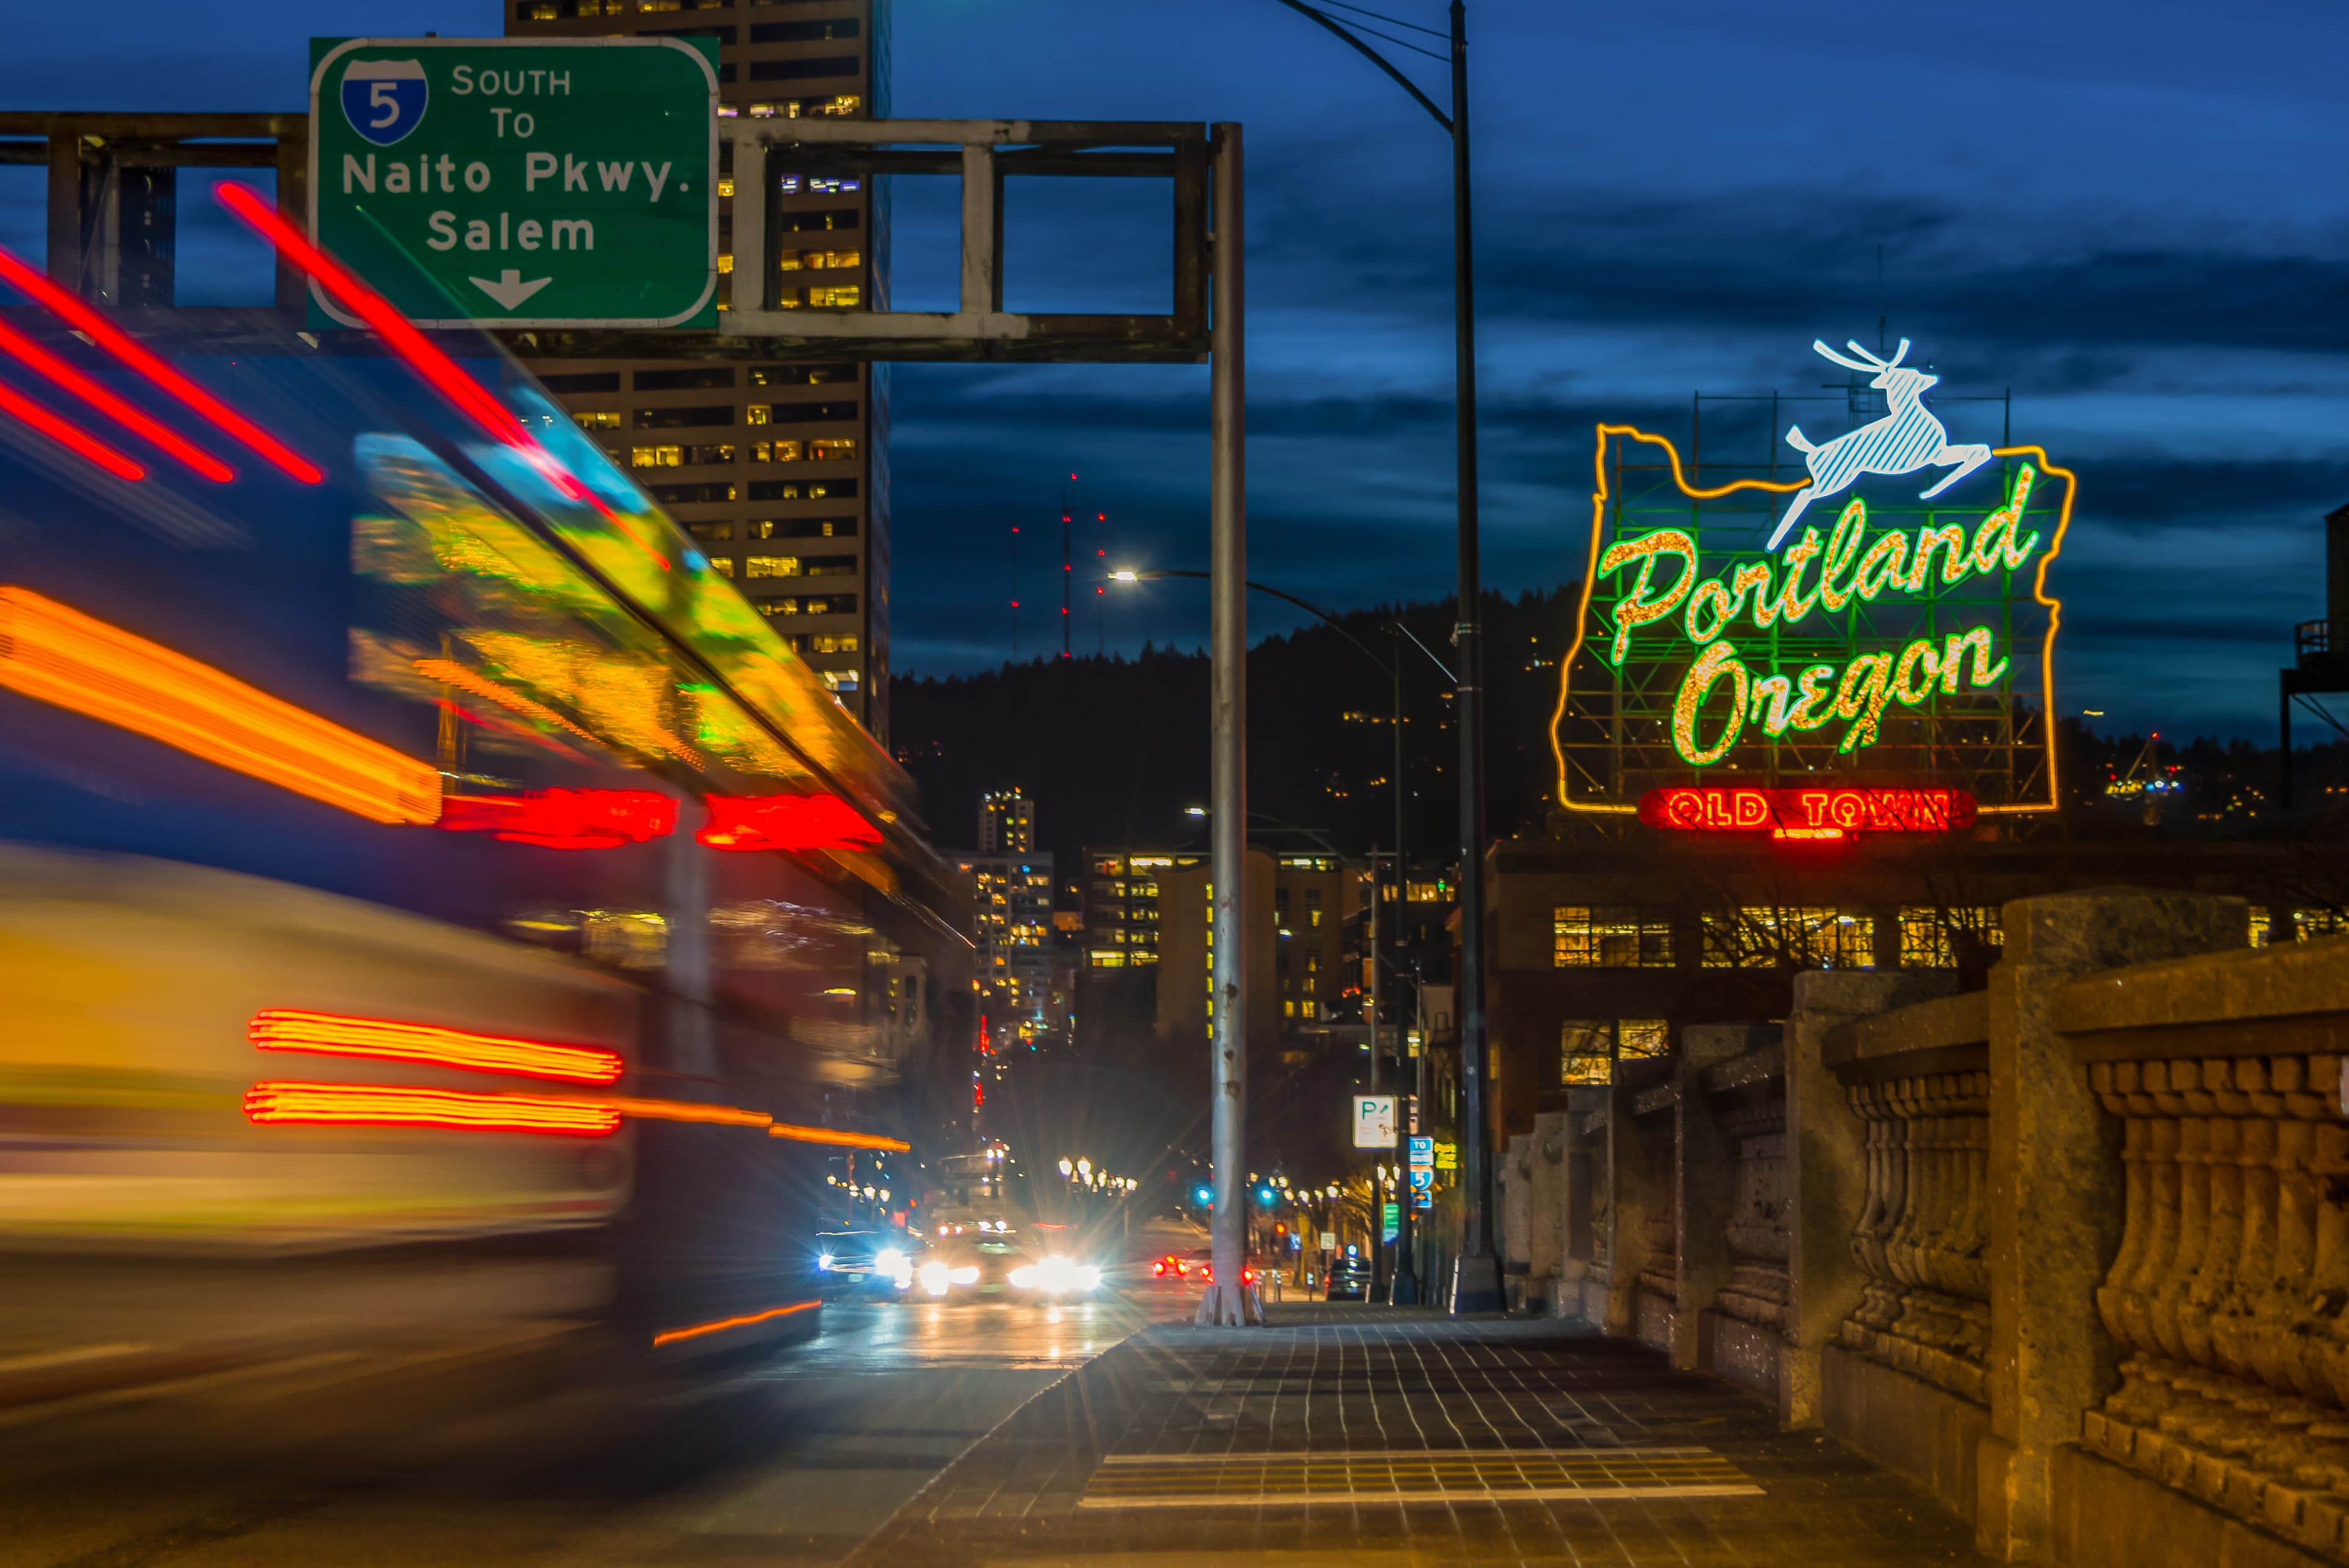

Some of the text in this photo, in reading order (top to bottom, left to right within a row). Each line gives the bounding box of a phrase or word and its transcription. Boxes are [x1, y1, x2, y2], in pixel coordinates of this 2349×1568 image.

[451, 65, 571, 96] SOUTH
[370, 82, 400, 129] 5
[343, 153, 689, 203] Naito Pkwy.
[426, 210, 594, 251] Salem
[1598, 463, 2040, 665] Portland
[1672, 626, 2009, 765] Oregon
[1669, 792, 1949, 827] OLD TOWN
[1362, 1101, 1377, 1120] P
[1415, 1172, 1425, 1186] 5
